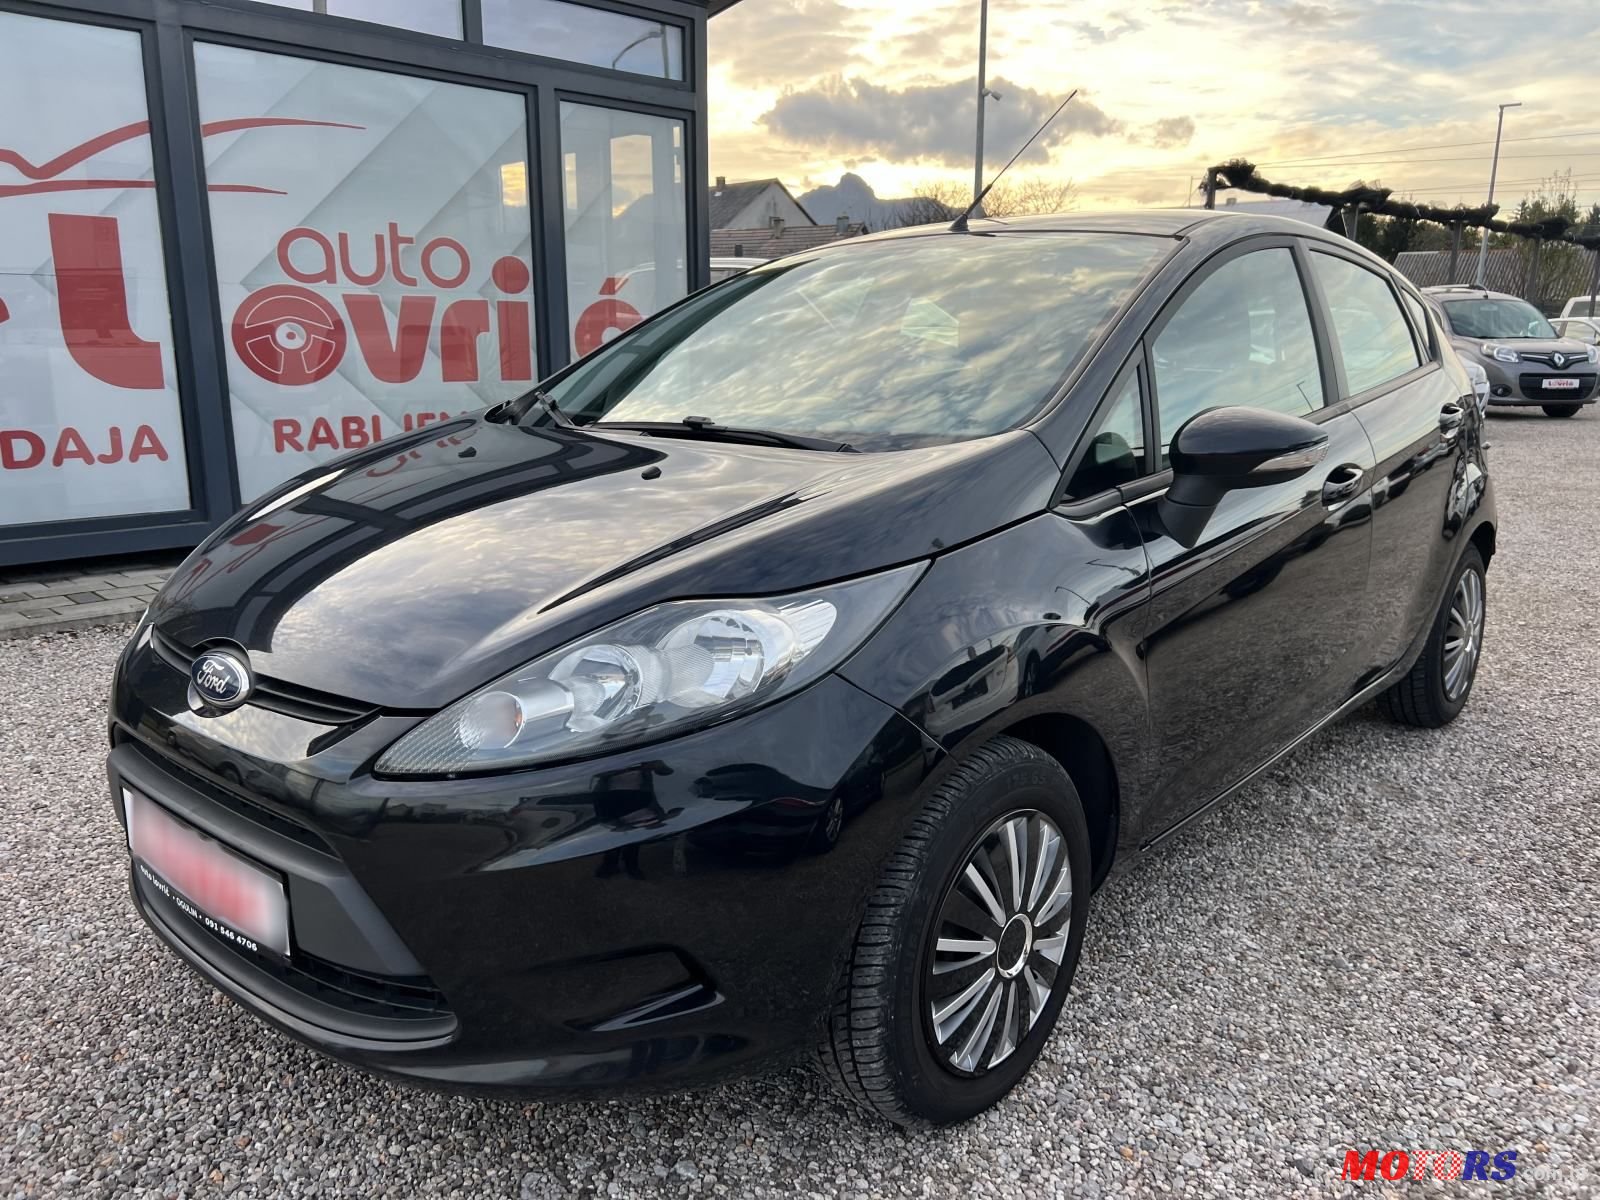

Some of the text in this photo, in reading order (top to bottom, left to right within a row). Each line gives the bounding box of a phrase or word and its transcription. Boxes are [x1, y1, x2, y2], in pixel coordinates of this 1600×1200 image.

[276, 222, 471, 288] auto
[197, 660, 230, 694] Ford
[176, 897, 198, 919] OGULIN
[205, 917, 218, 931] 091
[236, 935, 258, 952] 4706
